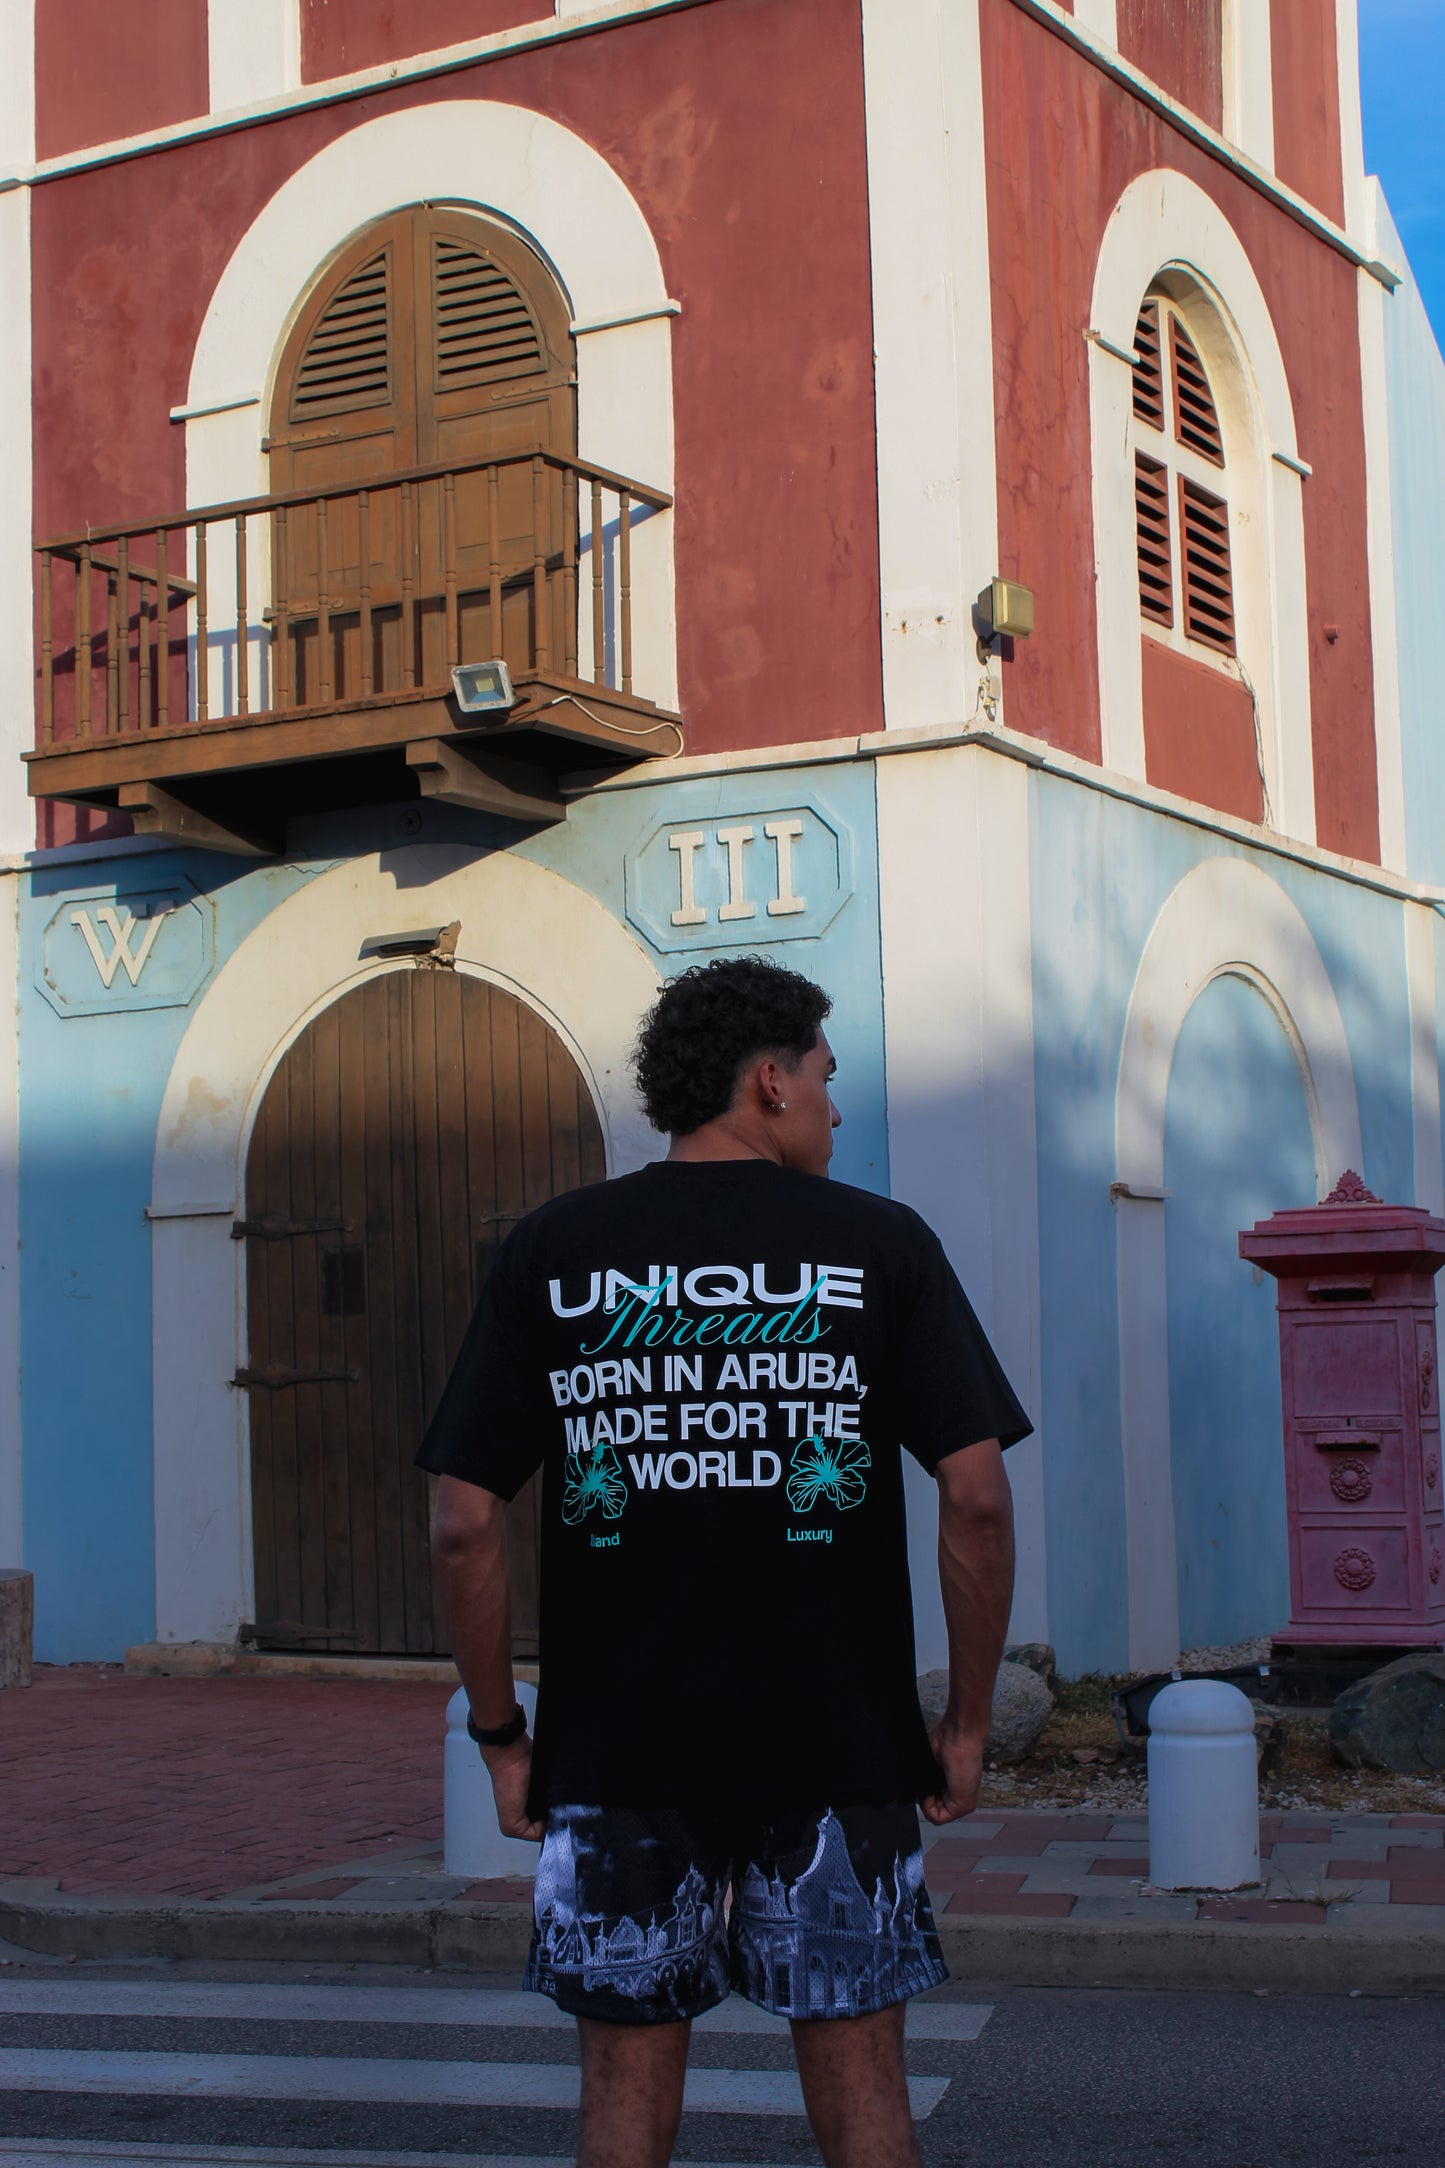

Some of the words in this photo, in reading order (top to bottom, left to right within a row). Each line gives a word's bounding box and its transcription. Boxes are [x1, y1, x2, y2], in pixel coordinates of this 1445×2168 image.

[669, 819, 805, 926] III
[70, 900, 175, 989] W
[549, 1263, 864, 1318] UNIQUE
[580, 1275, 832, 1355] Threads
[549, 1356, 652, 1407] BORN
[664, 1354, 703, 1392] IN
[716, 1352, 868, 1401] ARUBA,
[564, 1404, 669, 1454] MADE
[680, 1401, 767, 1441] FOR
[778, 1401, 861, 1440] THE
[628, 1450, 782, 1490] WORLD
[786, 1527, 833, 1544] Luxury
